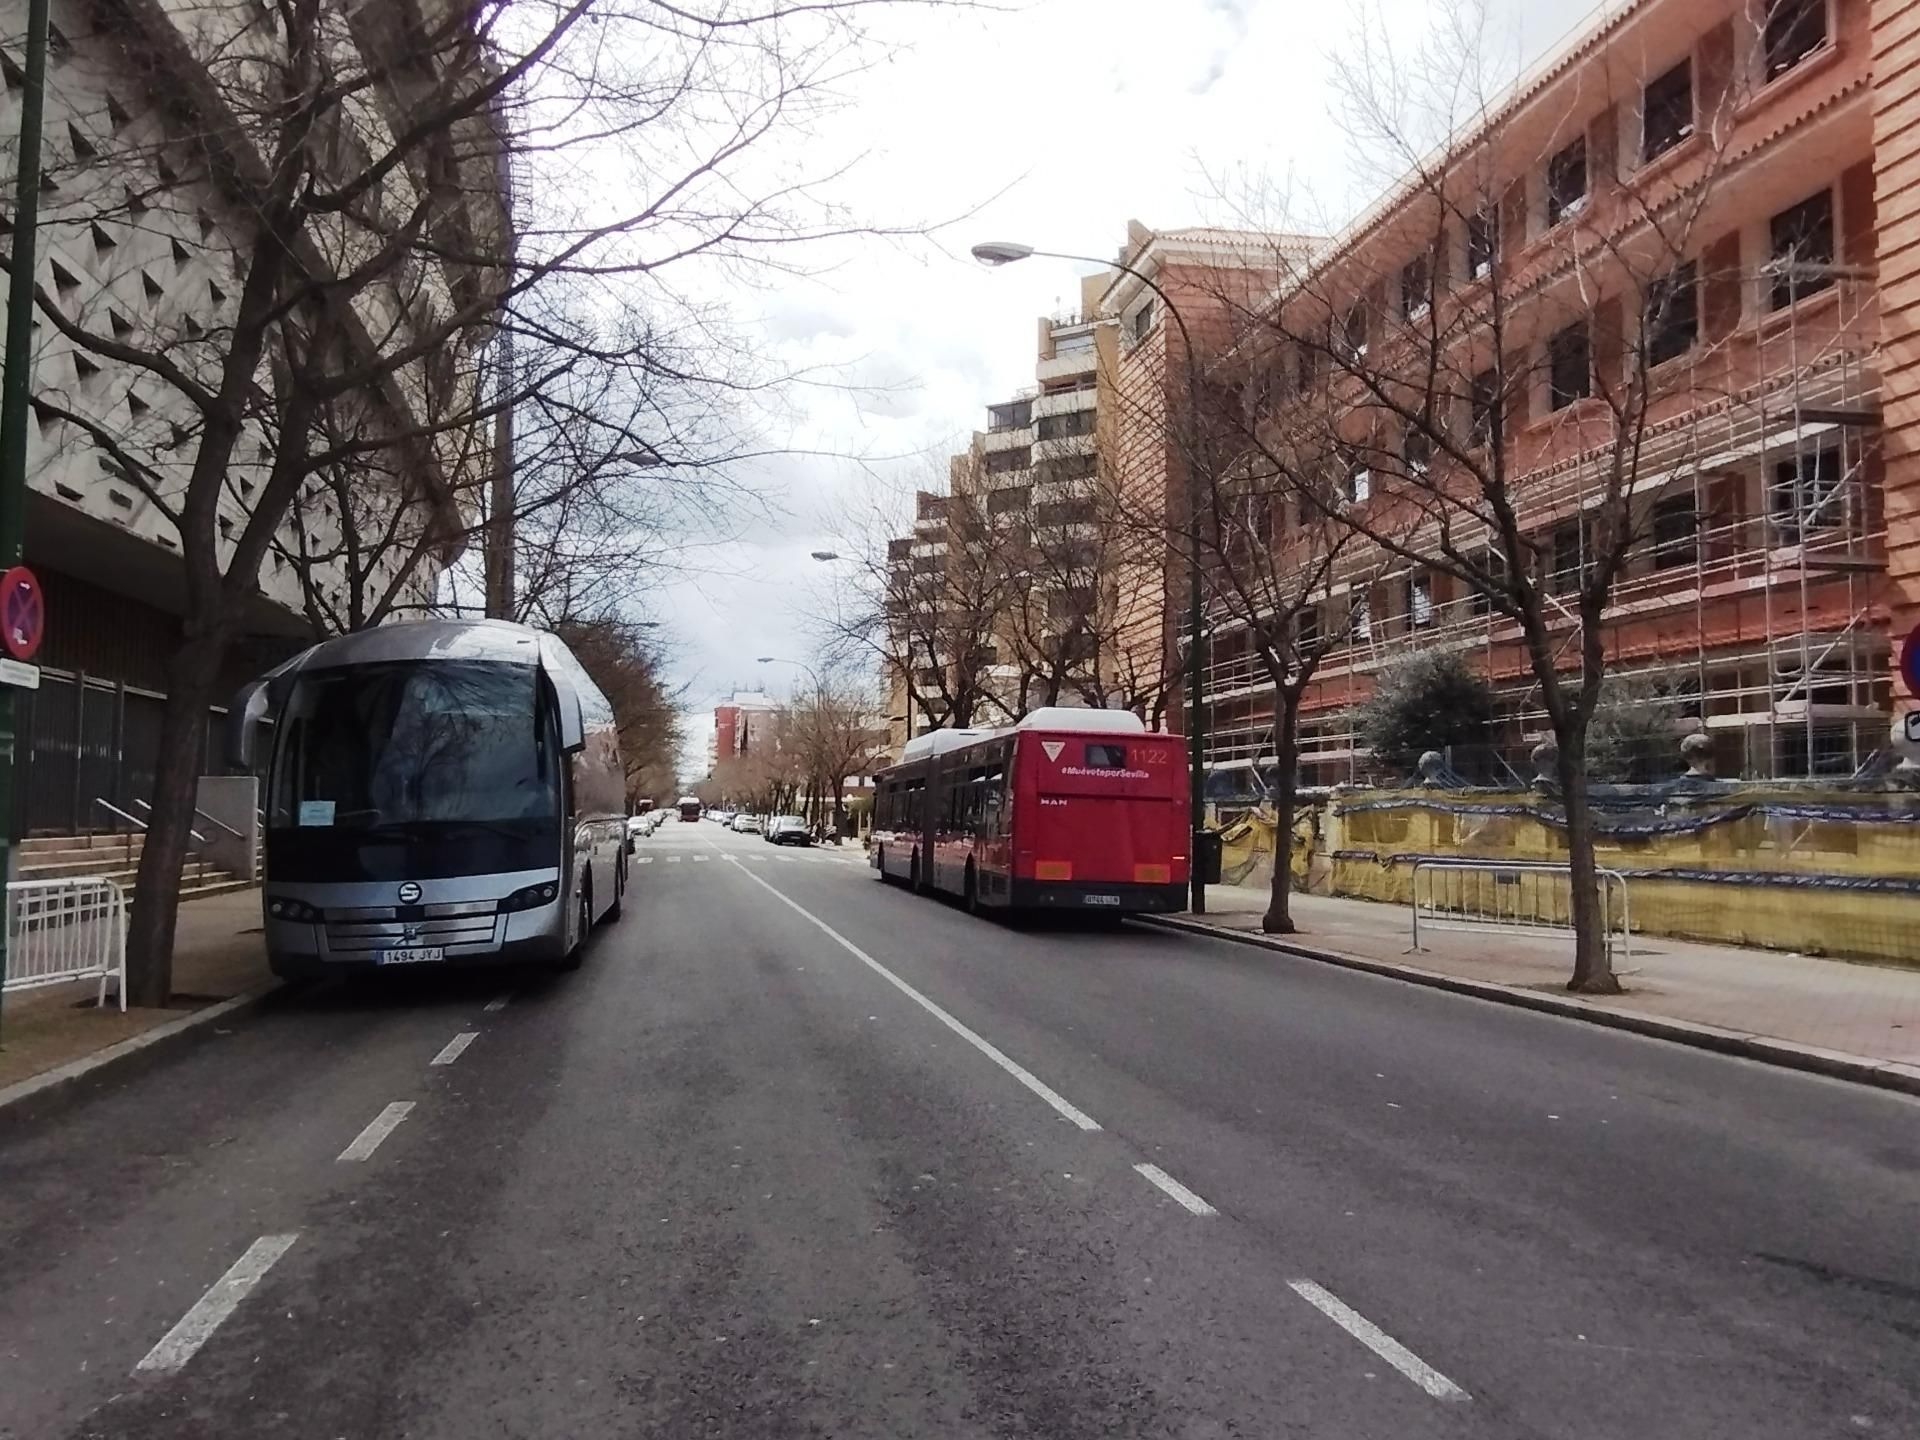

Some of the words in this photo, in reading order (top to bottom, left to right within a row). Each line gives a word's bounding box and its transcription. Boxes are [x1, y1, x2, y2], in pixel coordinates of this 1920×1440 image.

[1130, 749, 1168, 764] 1122
[1040, 798, 1068, 806] MAN
[387, 950, 415, 963] 1494
[420, 948, 441, 960] JYJ
